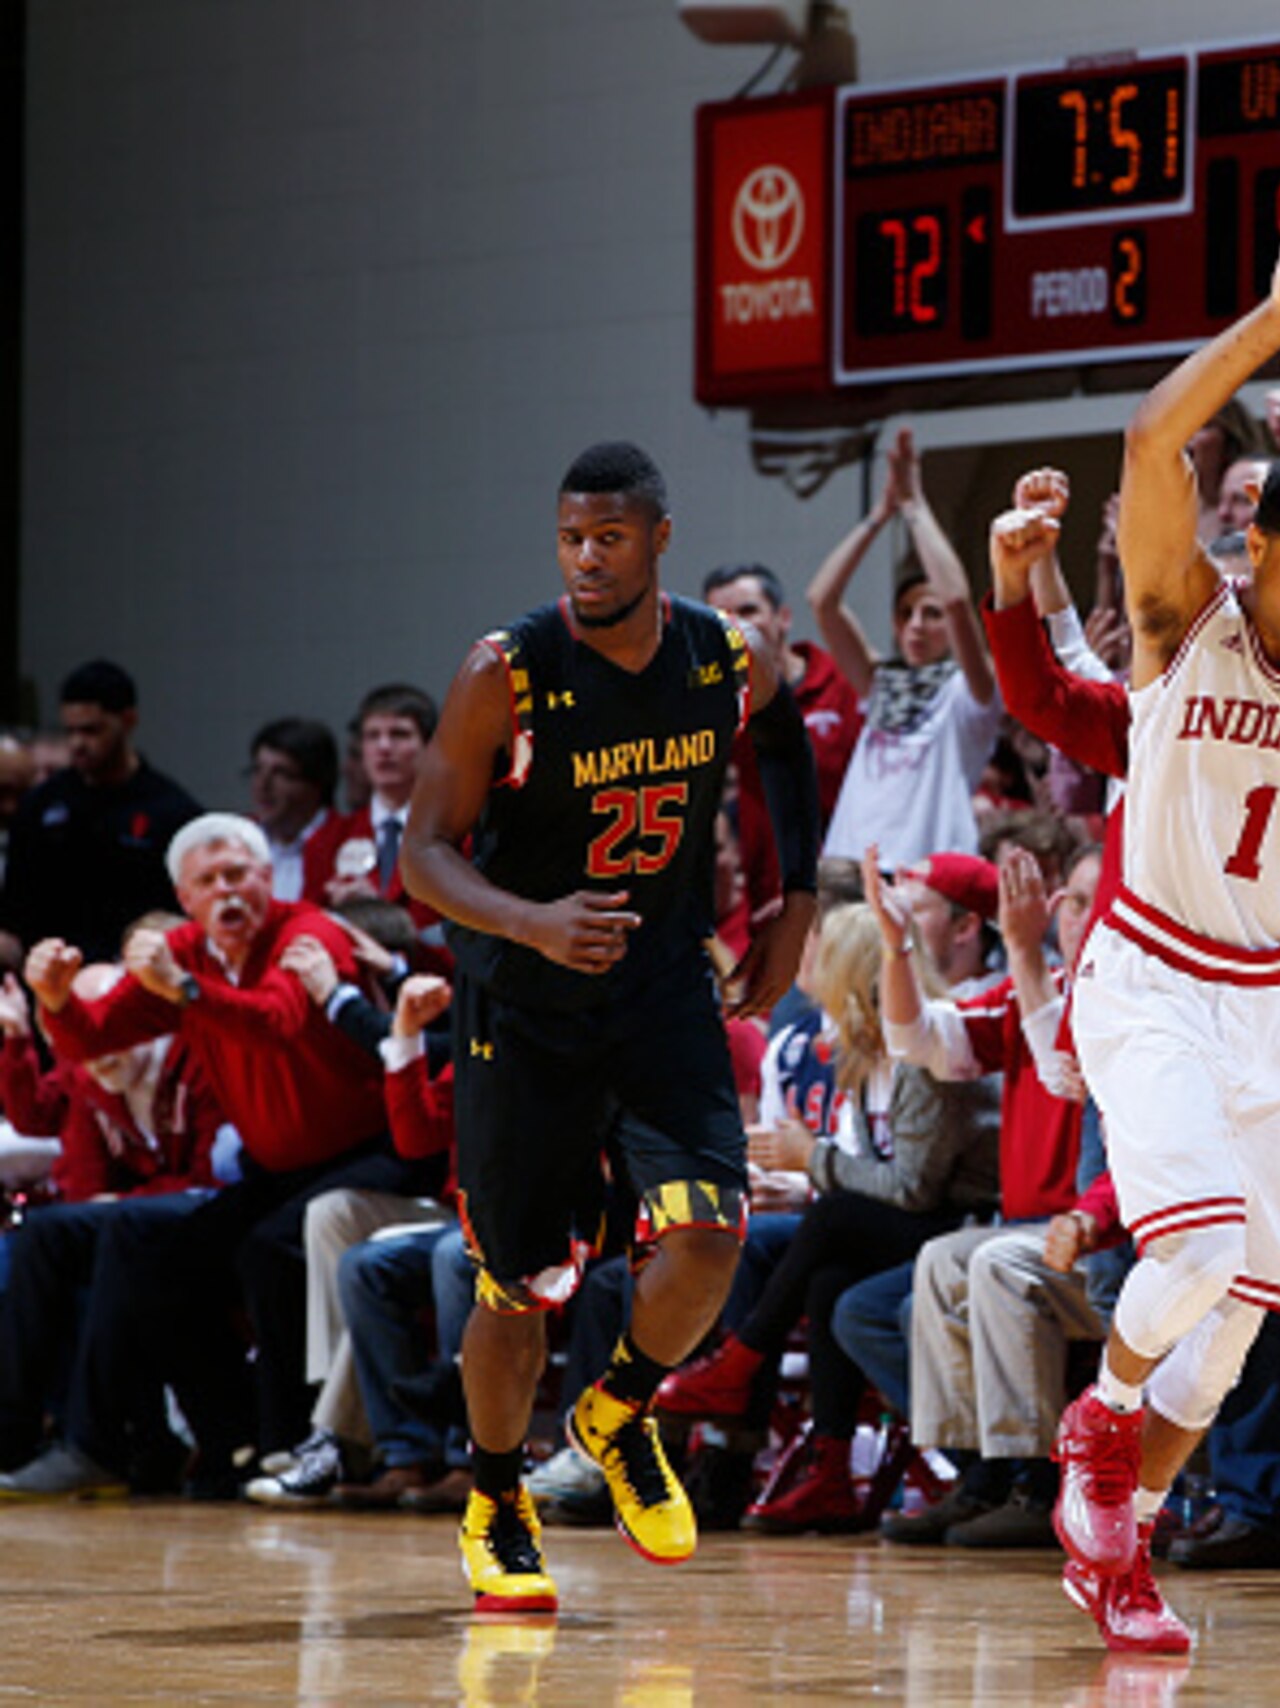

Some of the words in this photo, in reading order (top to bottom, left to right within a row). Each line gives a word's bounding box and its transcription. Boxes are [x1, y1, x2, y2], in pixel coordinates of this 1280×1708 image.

[720, 276, 815, 324] TOYOTA
[878, 214, 942, 324] 72
[1031, 266, 1108, 318] PERIOD
[1114, 237, 1141, 318] 2
[572, 729, 716, 788] MARYLAND
[586, 780, 689, 879] 25
[1223, 783, 1279, 882] 1
